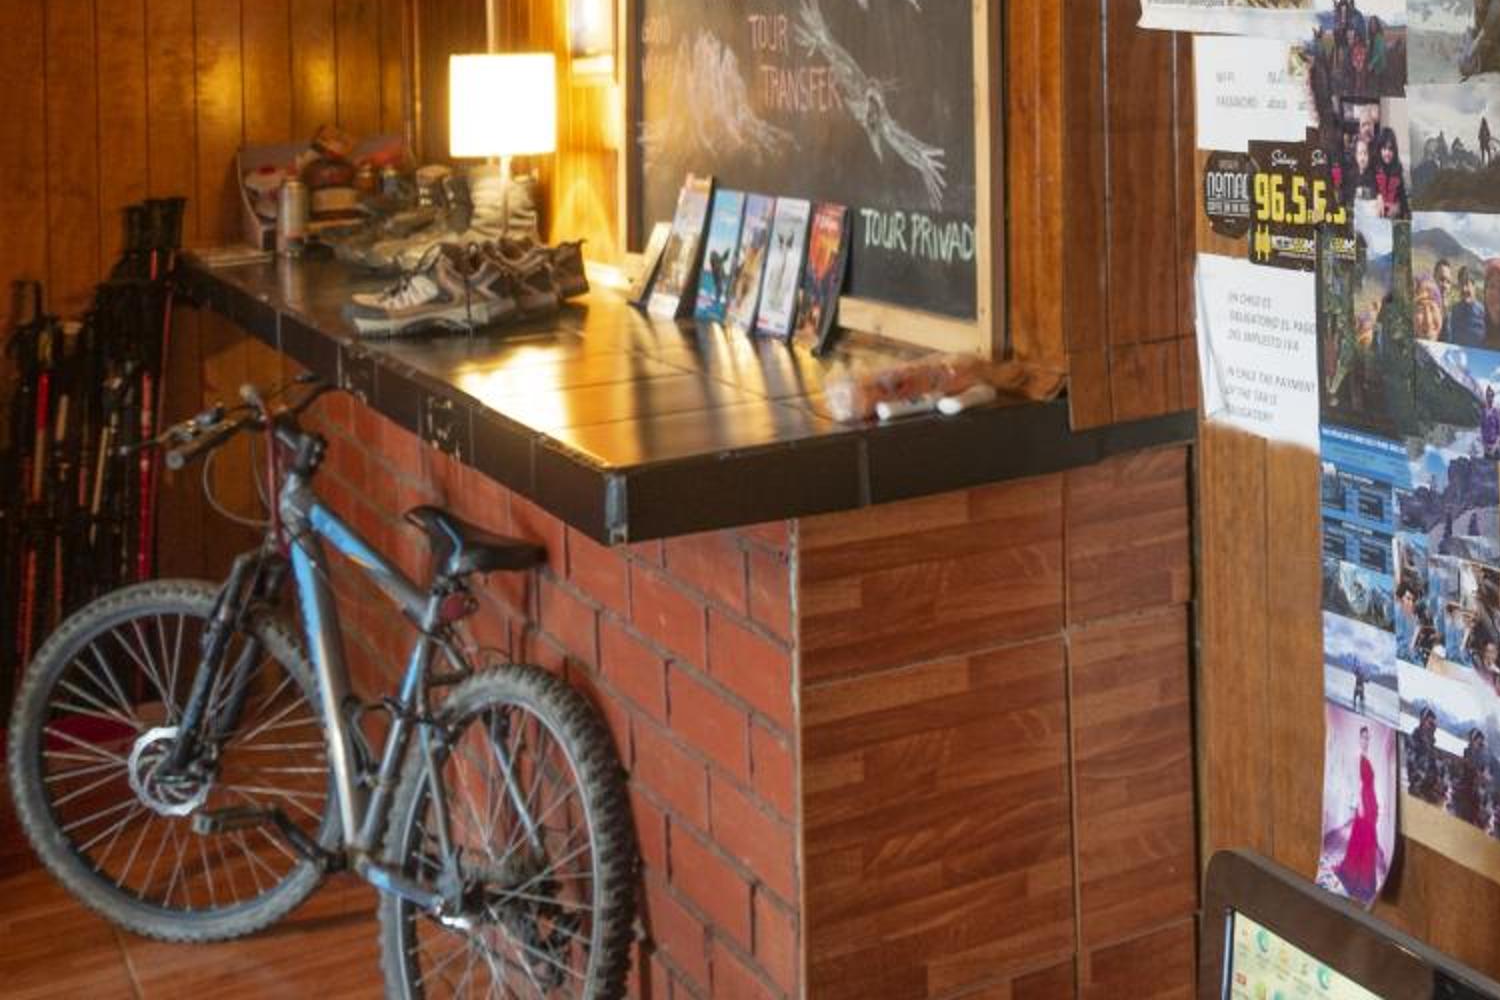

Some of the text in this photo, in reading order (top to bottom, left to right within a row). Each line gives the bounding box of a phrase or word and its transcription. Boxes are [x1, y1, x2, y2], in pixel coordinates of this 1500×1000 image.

[748, 13, 789, 54] TOUR
[759, 64, 843, 112] TRANSFER
[861, 208, 907, 252] TOUR
[910, 214, 977, 264] PRIVAD
